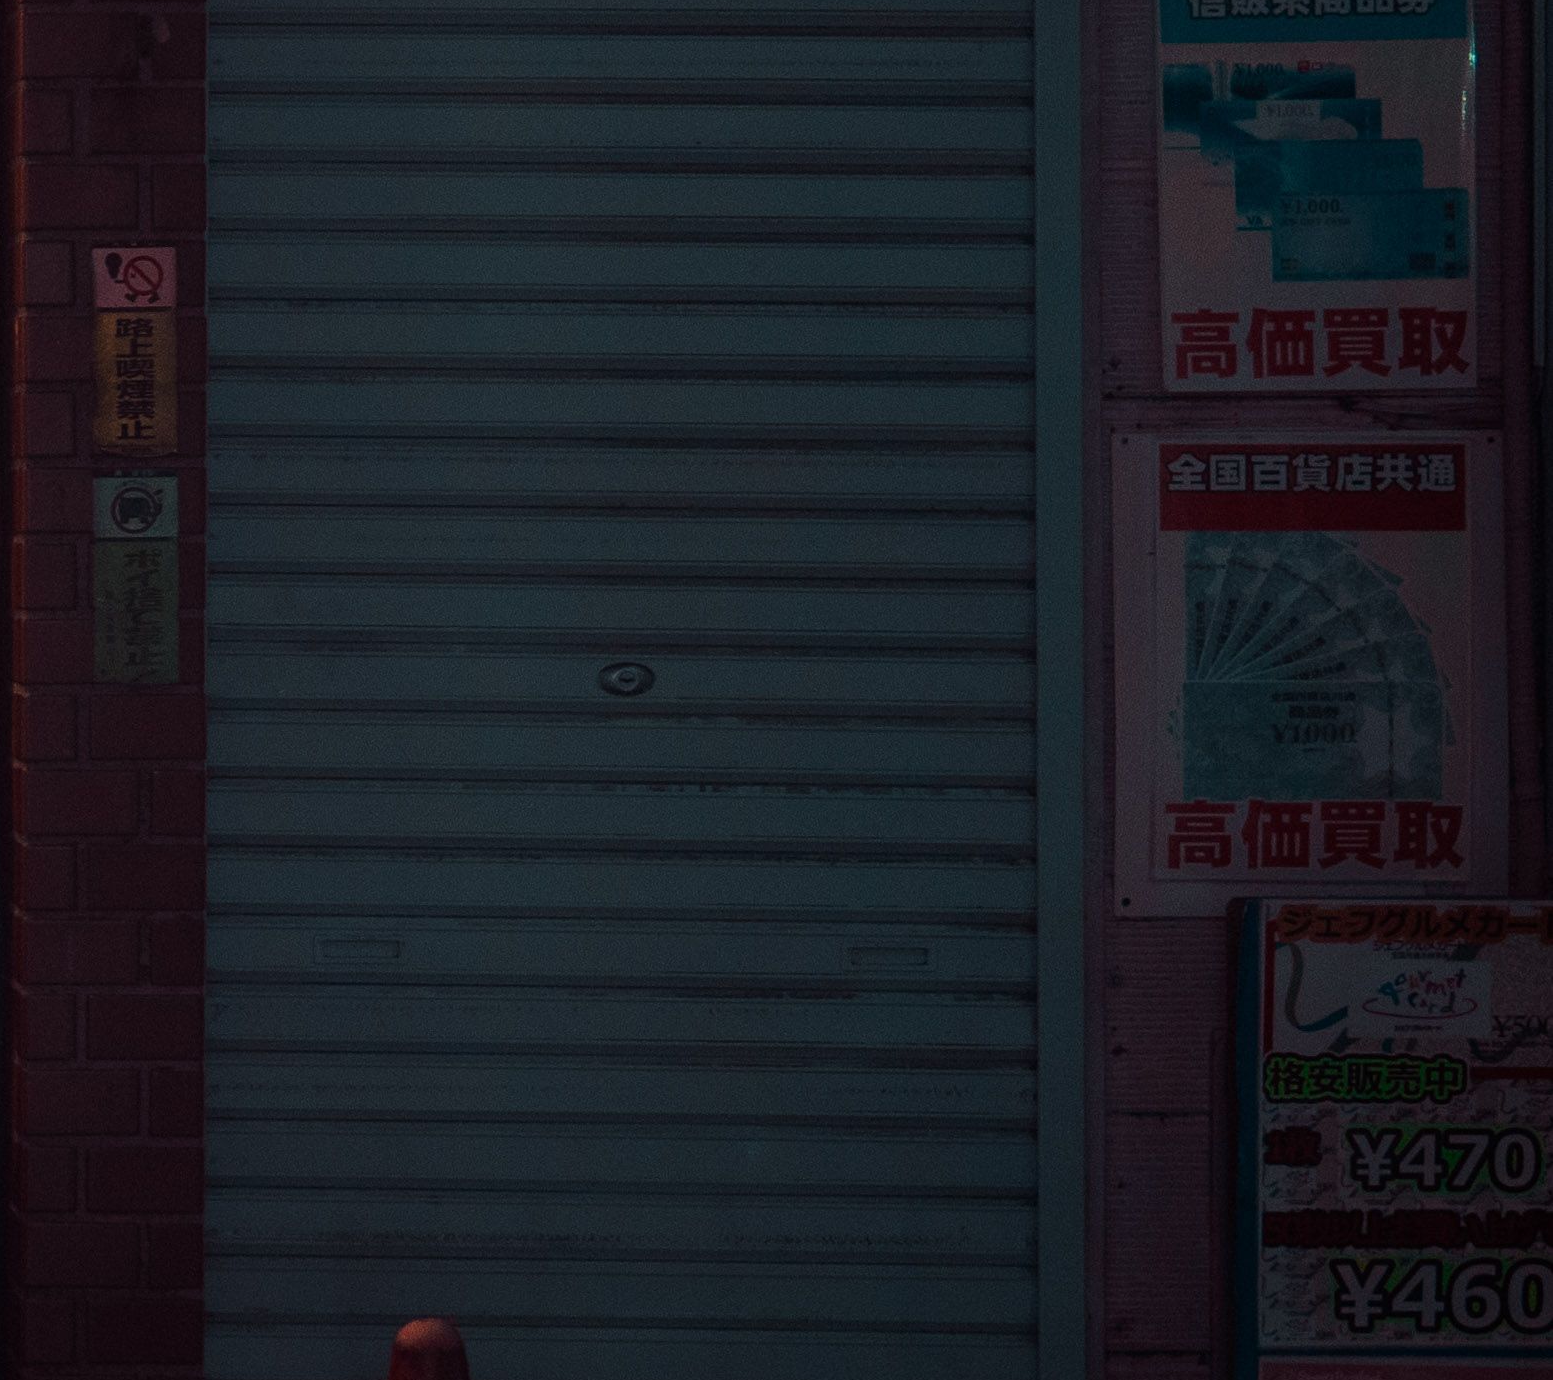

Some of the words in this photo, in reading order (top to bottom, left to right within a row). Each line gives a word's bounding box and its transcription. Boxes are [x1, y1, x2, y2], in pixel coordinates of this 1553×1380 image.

[1171, 306, 1472, 379] 高価買取
[115, 317, 155, 441] 路上喫煙禁止
[1166, 452, 1457, 494] 全国百貨店共通
[1163, 798, 1465, 869] 高価買取
[1283, 908, 1553, 939] ジェフグルメカー
[1269, 1059, 1461, 1096] 格安販売中
[1348, 1128, 1541, 1192] ¥470
[1331, 1257, 1553, 1333] ¥460
